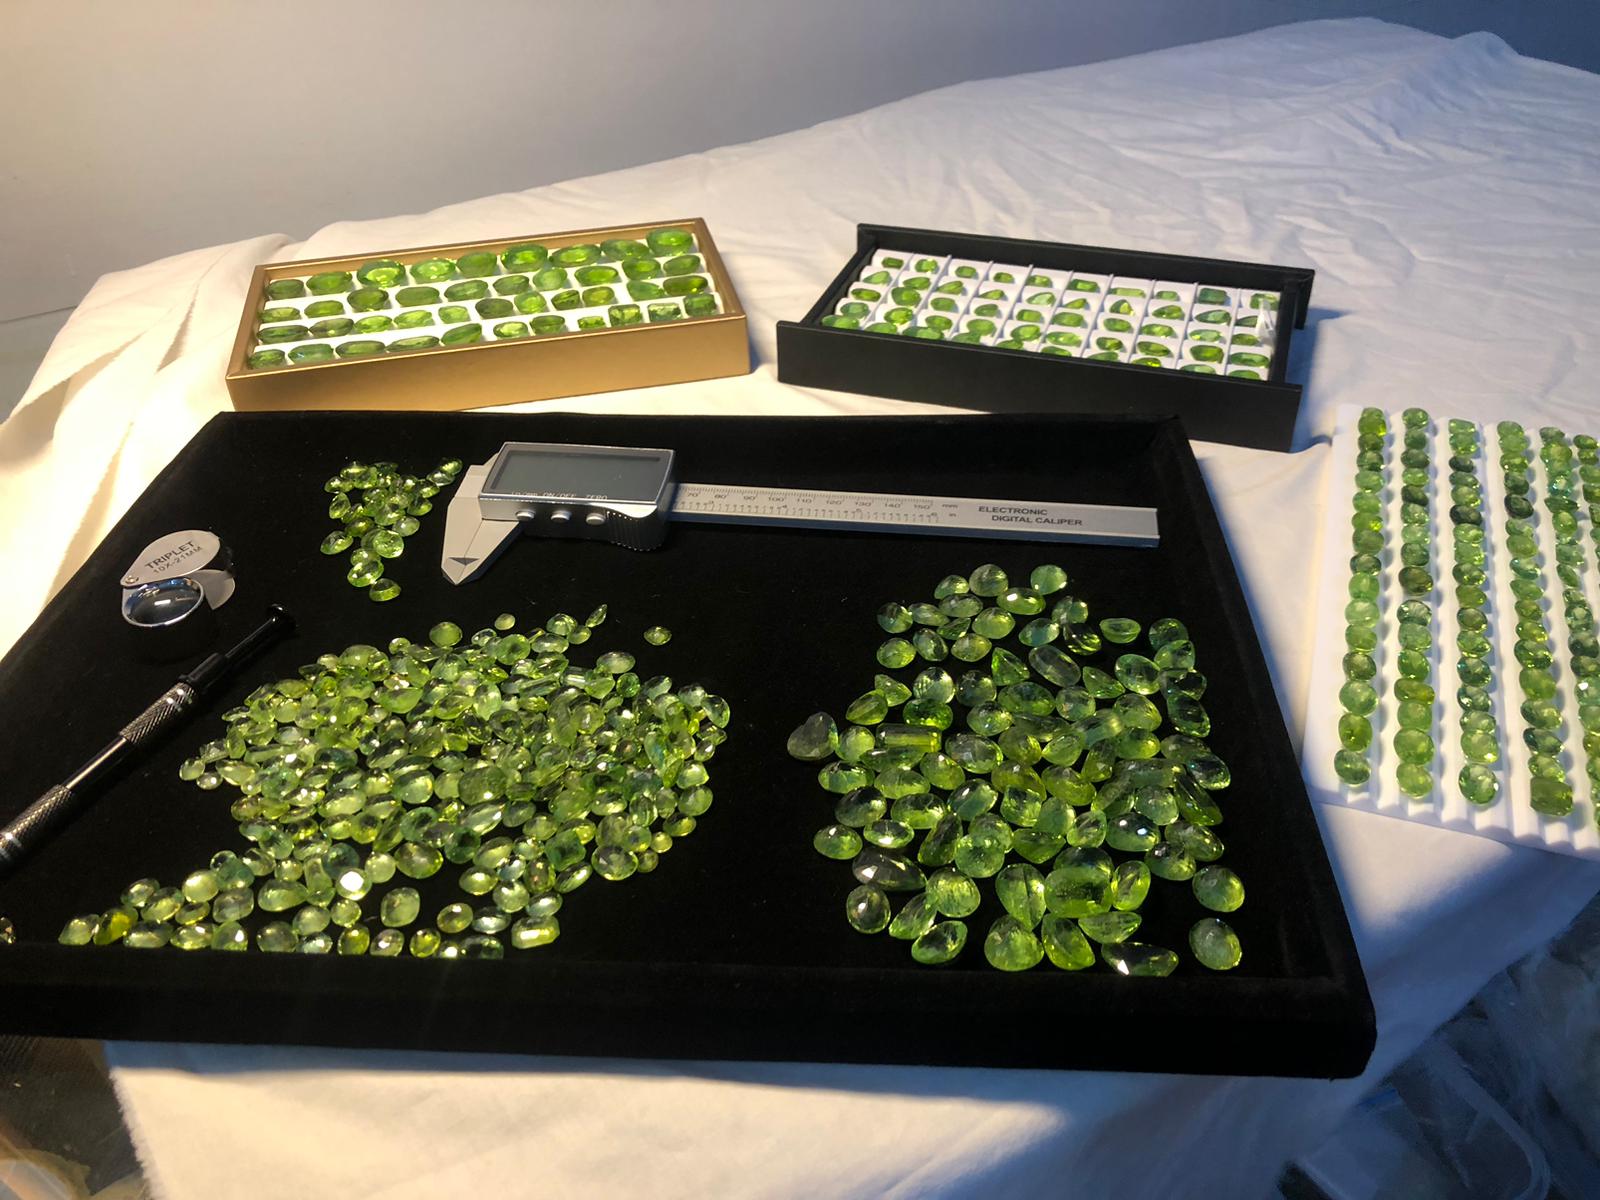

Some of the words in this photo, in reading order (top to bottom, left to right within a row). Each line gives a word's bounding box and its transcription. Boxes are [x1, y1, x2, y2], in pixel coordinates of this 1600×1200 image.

[978, 505, 1048, 516] ELECTRONIC
[992, 514, 1032, 523] DIGITAL
[1035, 516, 1083, 526] CALIPER
[145, 540, 195, 570] TRIPLET
[153, 546, 203, 574] 10X-21MM
